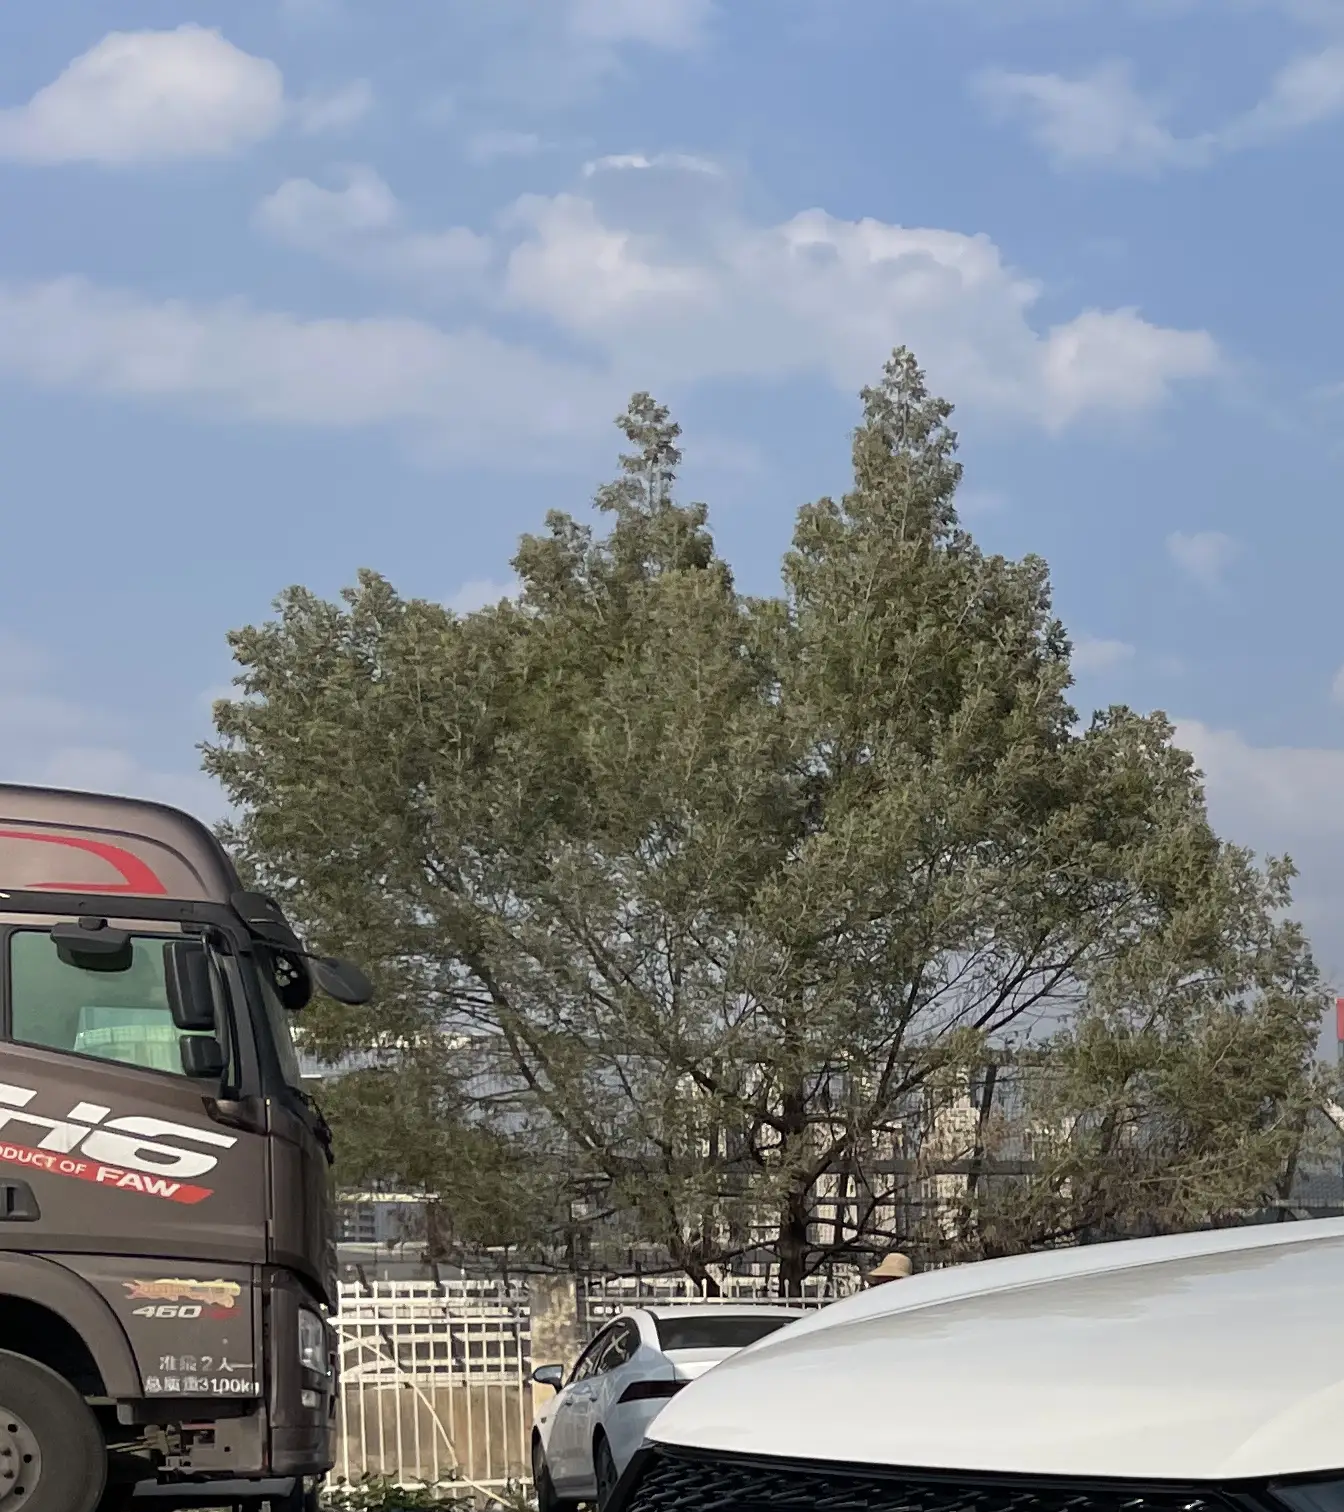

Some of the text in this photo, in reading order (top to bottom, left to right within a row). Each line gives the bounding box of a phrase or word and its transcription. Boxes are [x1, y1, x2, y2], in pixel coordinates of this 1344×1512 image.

[0, 1145, 181, 1198] DUCT OF FAW
[132, 1305, 202, 1318] 460
